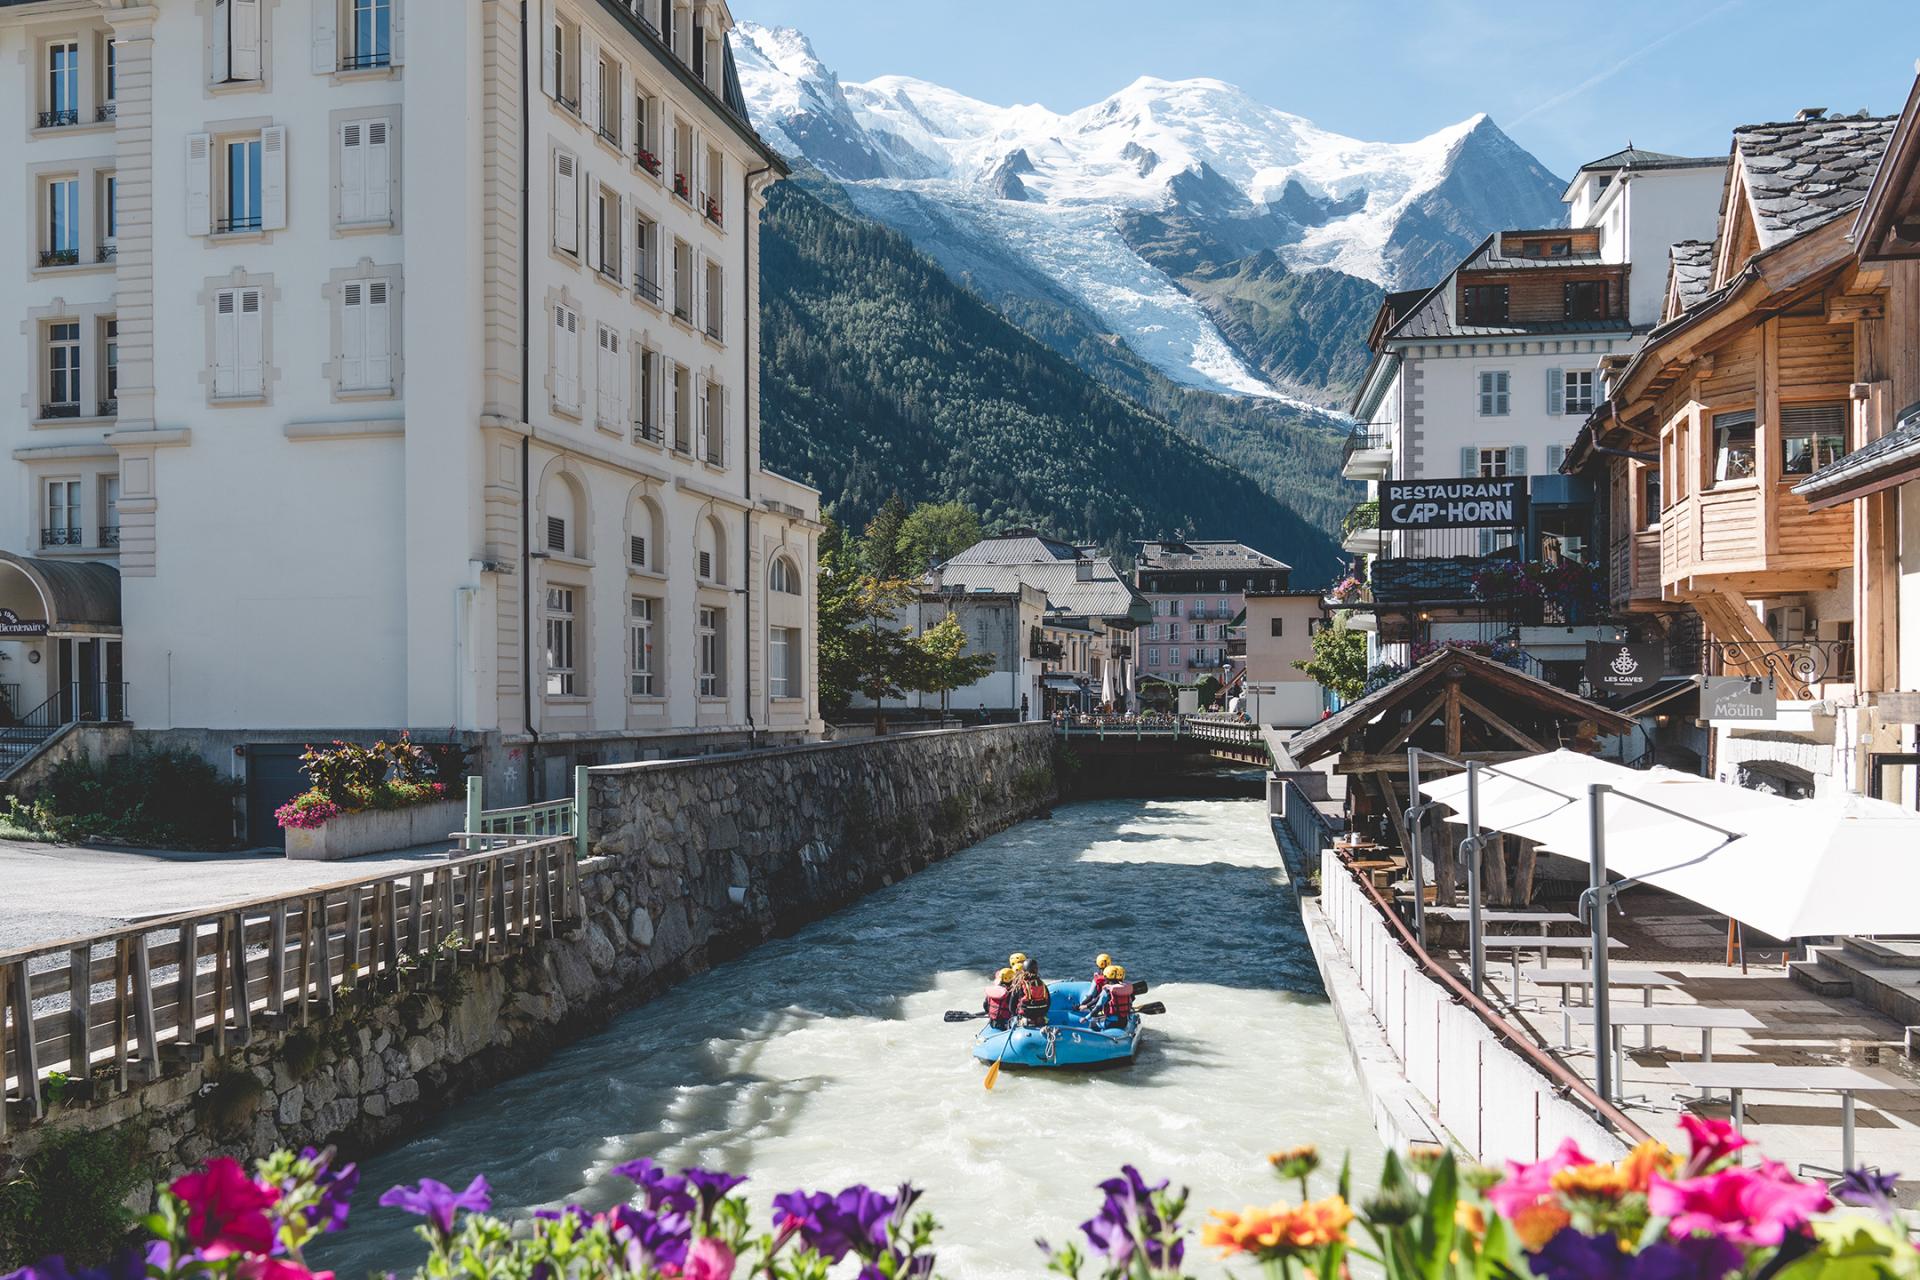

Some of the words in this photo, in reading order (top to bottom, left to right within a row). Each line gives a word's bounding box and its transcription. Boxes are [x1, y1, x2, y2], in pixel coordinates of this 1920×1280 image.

[1390, 483, 1514, 500] RESTAURANT
[1391, 501, 1512, 524] CAP-HORN
[1714, 703, 1763, 717] Moulin
